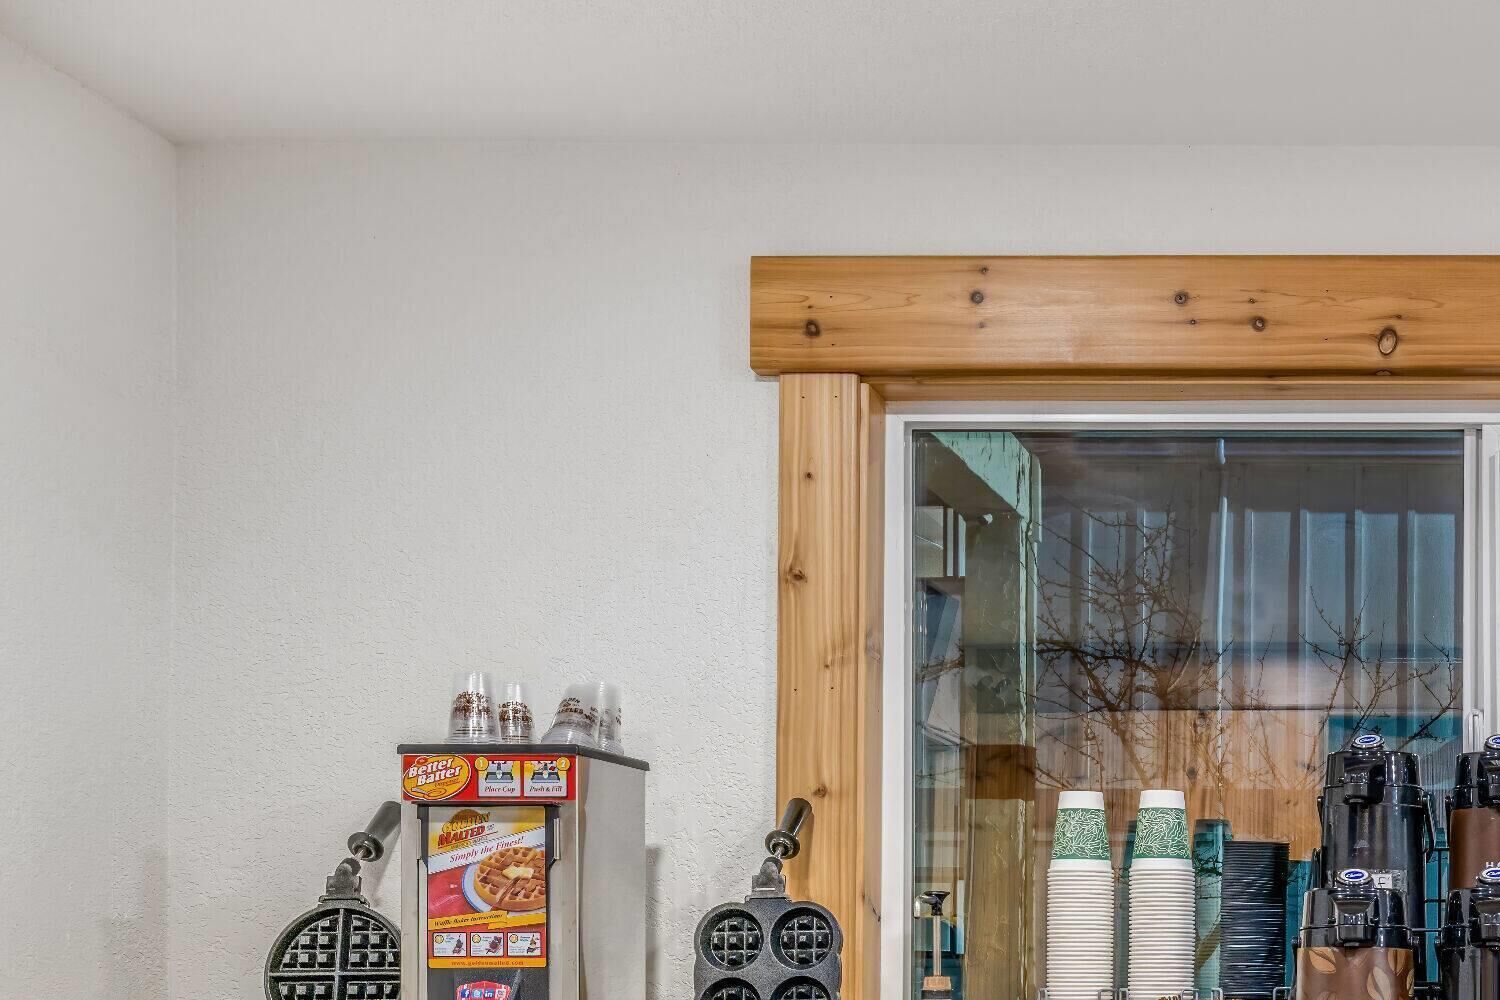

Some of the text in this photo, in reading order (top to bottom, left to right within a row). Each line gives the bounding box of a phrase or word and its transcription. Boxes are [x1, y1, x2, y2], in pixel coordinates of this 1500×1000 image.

[408, 758, 454, 778] Better
[416, 766, 462, 786] Batter
[502, 786, 516, 794] Cup
[438, 825, 486, 847] MALTED
[450, 849, 478, 863] Simply
[481, 844, 493, 855] the
[496, 836, 524, 850] Finest!
